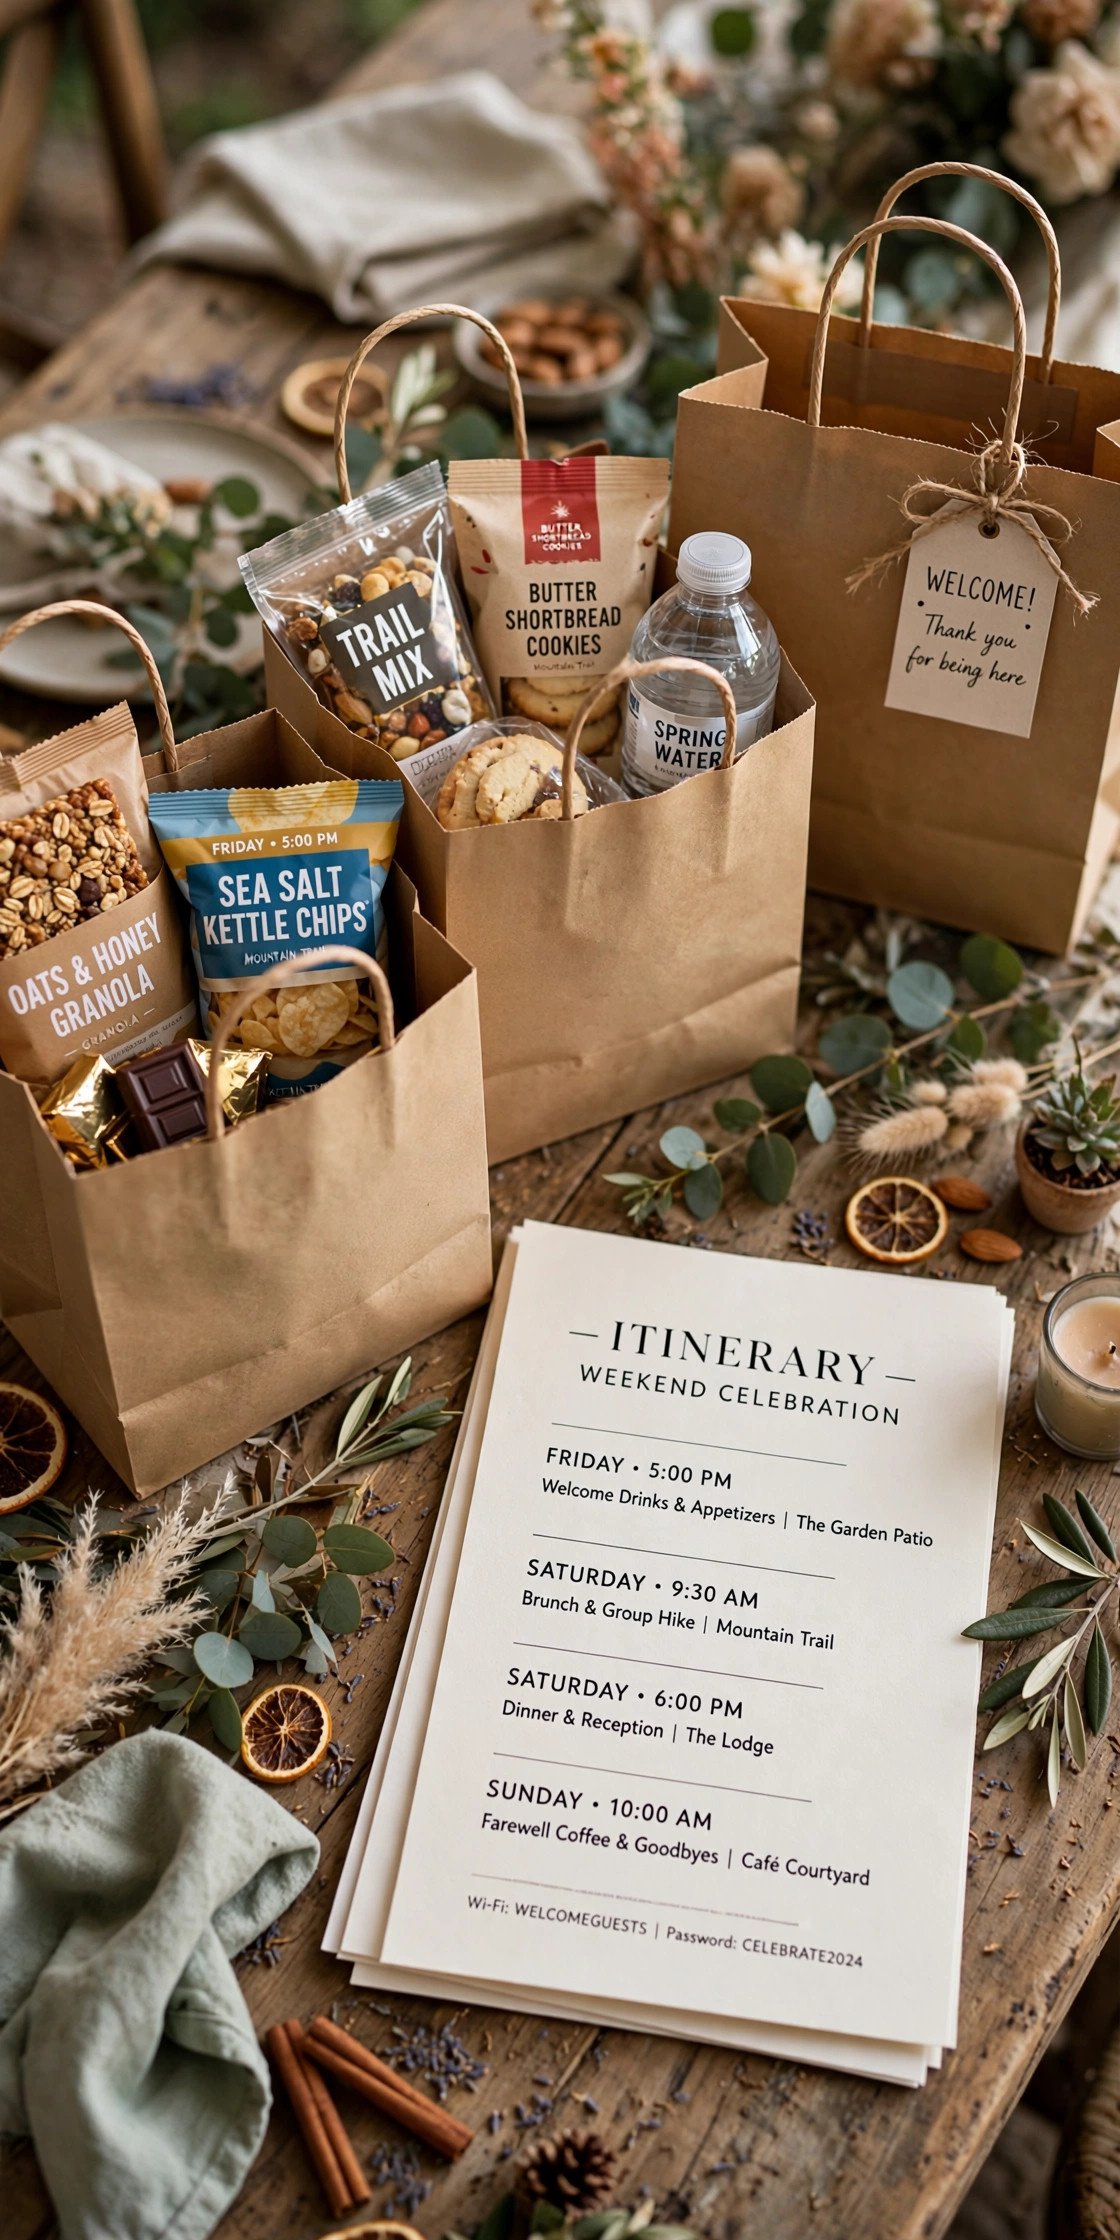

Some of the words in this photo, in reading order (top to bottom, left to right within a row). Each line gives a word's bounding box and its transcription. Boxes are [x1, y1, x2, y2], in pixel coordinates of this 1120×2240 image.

[529, 581, 597, 603] BUTTER
[928, 566, 1035, 612] WELCOME!
[336, 603, 425, 668] TRAIL
[505, 606, 621, 630] SHORTBREAD
[926, 614, 976, 641] Thank
[981, 634, 1016, 656] you
[527, 634, 601, 657] COOKIES
[906, 646, 934, 673] for
[939, 651, 982, 687] being
[989, 661, 1026, 685] here
[372, 645, 433, 701] MIX
[654, 720, 726, 747] SPRING
[655, 741, 722, 769] WATER
[212, 838, 264, 855] FRIDAY
[282, 834, 313, 848] 5:00
[318, 832, 338, 845] PM
[218, 872, 271, 908] SEA
[278, 865, 342, 902] SALT
[203, 909, 289, 945] KETTLE
[296, 901, 367, 938] CHIPS
[8, 965, 69, 1015] OATS
[71, 955, 93, 985] &
[91, 912, 161, 975] HONEY
[50, 963, 155, 1037] GRANOLA
[612, 1321, 875, 1386] ITINERARY
[581, 1364, 706, 1397] WEEKEND
[719, 1385, 898, 1425] CELEBRATION
[547, 1447, 624, 1473] FRIDAY
[649, 1463, 692, 1483] 5:00
[701, 1470, 731, 1489] PM
[543, 1478, 613, 1502] Welcome
[619, 1489, 668, 1509] Drinks
[674, 1497, 685, 1512] &
[691, 1500, 775, 1524] Appetizers
[797, 1515, 825, 1532] The
[831, 1520, 887, 1541] Garden
[894, 1528, 933, 1547] Patio
[527, 1559, 646, 1591] SATURDAY
[672, 1581, 716, 1602] 9:30
[724, 1589, 757, 1609] AM
[522, 1590, 578, 1612] Brunch
[585, 1600, 596, 1615] &
[603, 1602, 652, 1627] Group
[659, 1610, 695, 1629] Hike
[717, 1618, 793, 1644] Mountain
[801, 1631, 834, 1650] Trail
[507, 1668, 629, 1702] SATURDAY
[655, 1690, 701, 1712] 6:00
[710, 1698, 742, 1719] PM
[503, 1700, 559, 1722] Dinner
[563, 1709, 575, 1725] &
[582, 1712, 663, 1738] Reception
[686, 1727, 716, 1745] The
[722, 1732, 773, 1757] Lodge
[487, 1779, 583, 1809] SUNDAY
[611, 1798, 668, 1823] 10:00
[676, 1809, 711, 1830] AM
[482, 1813, 550, 1838] Farewell
[556, 1825, 610, 1847] Coffee
[616, 1833, 628, 1850] &
[635, 1837, 718, 1865] Goodbyes
[742, 1852, 779, 1872] Café
[786, 1859, 870, 1886] Courtyard
[468, 1896, 510, 1913] Wi-Fi:
[516, 1903, 646, 1934] WELCOMEGUESTS
[667, 1926, 737, 1948] Password:
[743, 1939, 862, 1967] CELEBRATE2024
